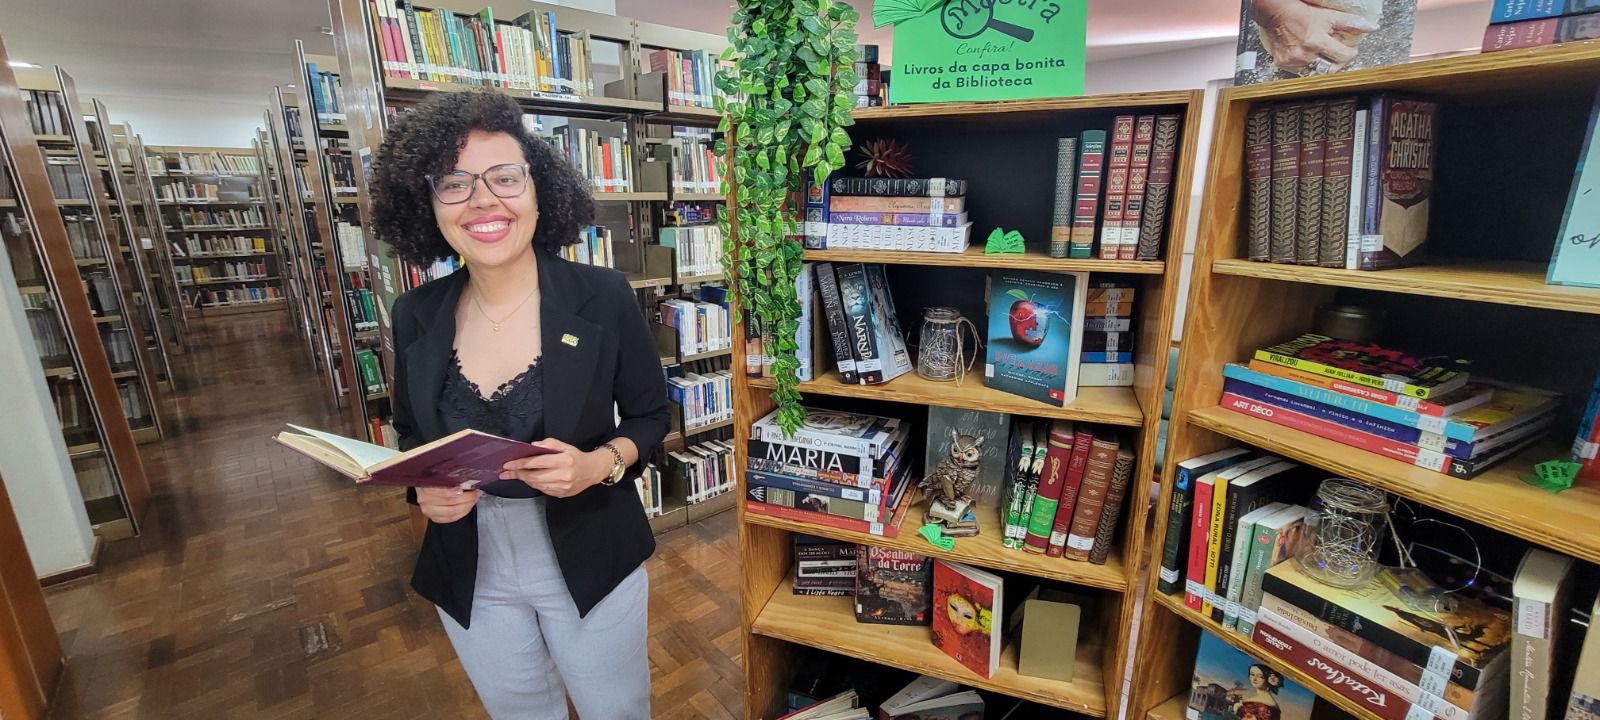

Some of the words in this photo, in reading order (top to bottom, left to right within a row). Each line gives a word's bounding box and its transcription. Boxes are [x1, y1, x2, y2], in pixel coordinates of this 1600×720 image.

[1495, 26, 1507, 49] Carlos
[1504, 26, 1517, 46] Nejar
[956, 41, 1015, 59] Confira!
[904, 64, 944, 75] Livros
[949, 62, 968, 73] da
[972, 62, 1010, 75] capa
[1015, 57, 1066, 71] bonita
[932, 78, 951, 89] da
[956, 75, 1033, 88] Biblioteca
[1391, 111, 1432, 140] AGATHA
[1389, 142, 1432, 170] CHRISTIE
[834, 214, 853, 223] Nora
[853, 214, 880, 223] Roberts
[819, 276, 834, 309] MARTIN
[1269, 354, 1299, 367] VIRALIZOU
[1232, 400, 1250, 411] ART
[1250, 403, 1275, 418] DÉCO
[766, 443, 844, 472] MARIA
[1213, 502, 1222, 523] ZONA
[1212, 523, 1220, 546] RURAL
[870, 545, 879, 559] O
[879, 546, 915, 561] Senhor
[878, 558, 891, 569] da
[891, 557, 921, 572] Torre
[1265, 636, 1285, 651] CRAIG
[1313, 638, 1323, 648] O
[1323, 643, 1346, 663] amor
[1347, 651, 1371, 674] pode
[1388, 678, 1410, 696] asas
[1307, 657, 1387, 709] Retalhos
